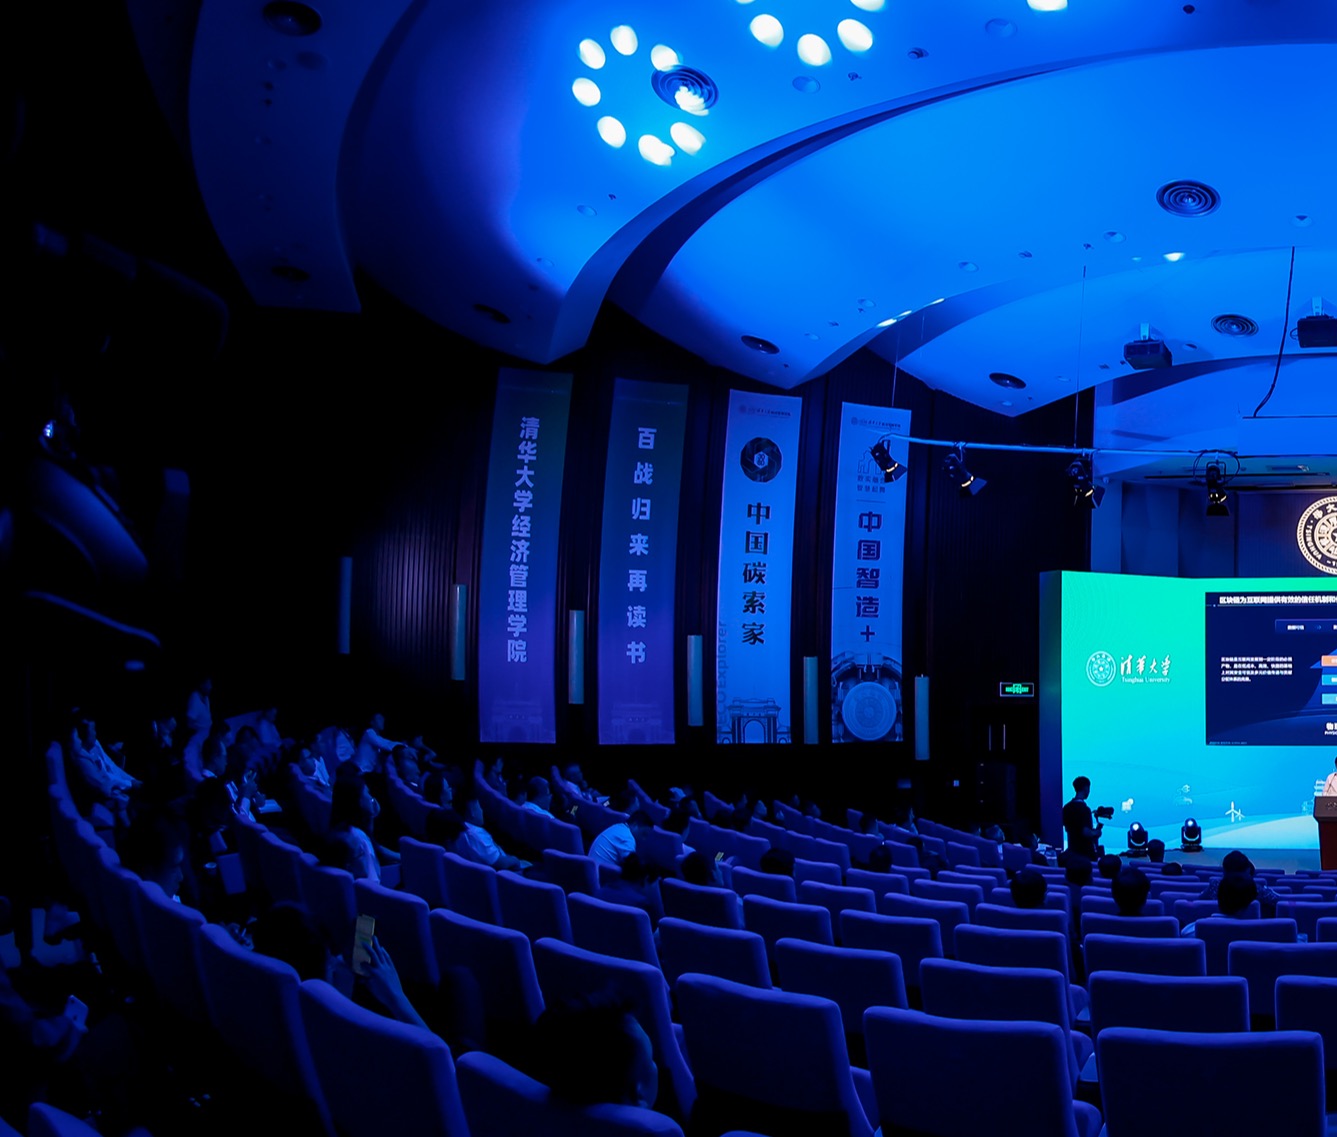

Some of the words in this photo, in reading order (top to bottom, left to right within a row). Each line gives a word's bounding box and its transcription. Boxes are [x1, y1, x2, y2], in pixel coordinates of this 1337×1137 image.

[507, 416, 540, 663] 清华大学经济管理学院
[626, 427, 657, 664] 百战归来再读书
[741, 502, 772, 646] 中国碳索家
